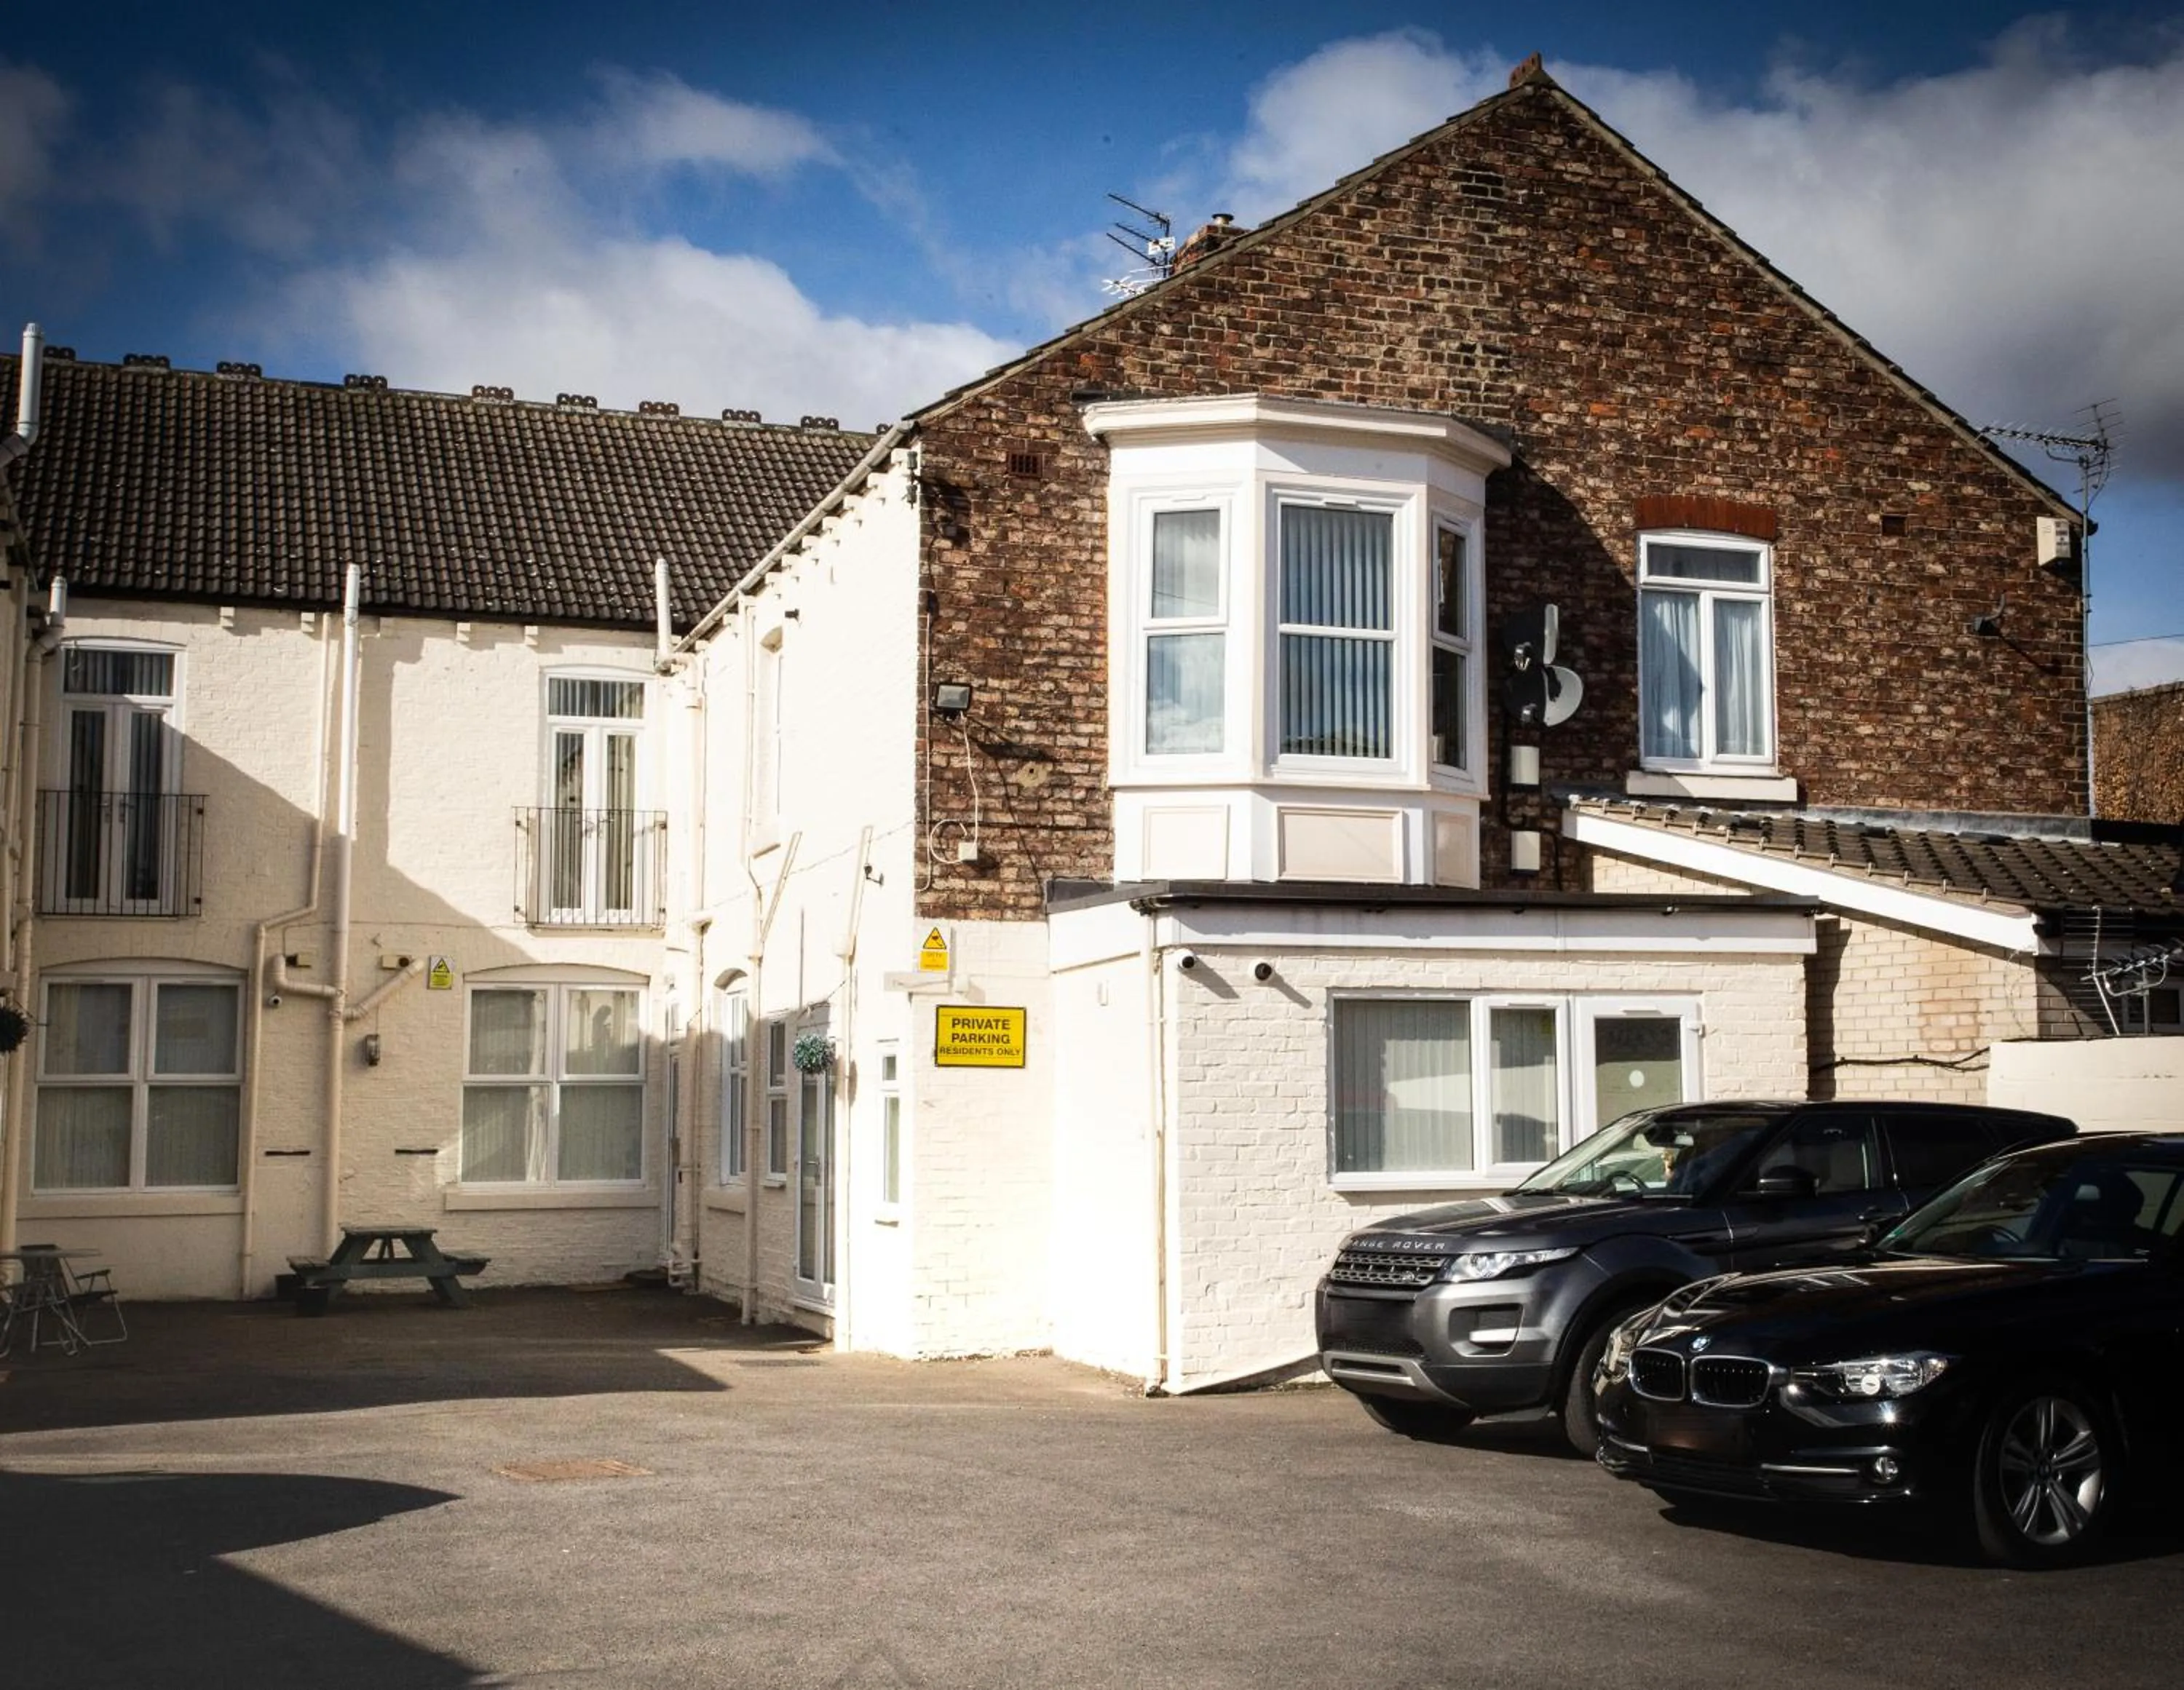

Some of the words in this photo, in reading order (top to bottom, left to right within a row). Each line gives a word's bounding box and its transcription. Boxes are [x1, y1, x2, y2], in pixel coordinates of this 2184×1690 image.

[951, 1017, 1010, 1030] PRIVATE
[951, 1033, 1010, 1044] PARKING
[939, 1046, 994, 1055] RESIDENTS
[997, 1047, 1021, 1055] ONLY
[1350, 1239, 1385, 1248] ANGE
[1391, 1240, 1445, 1250] ROVER
